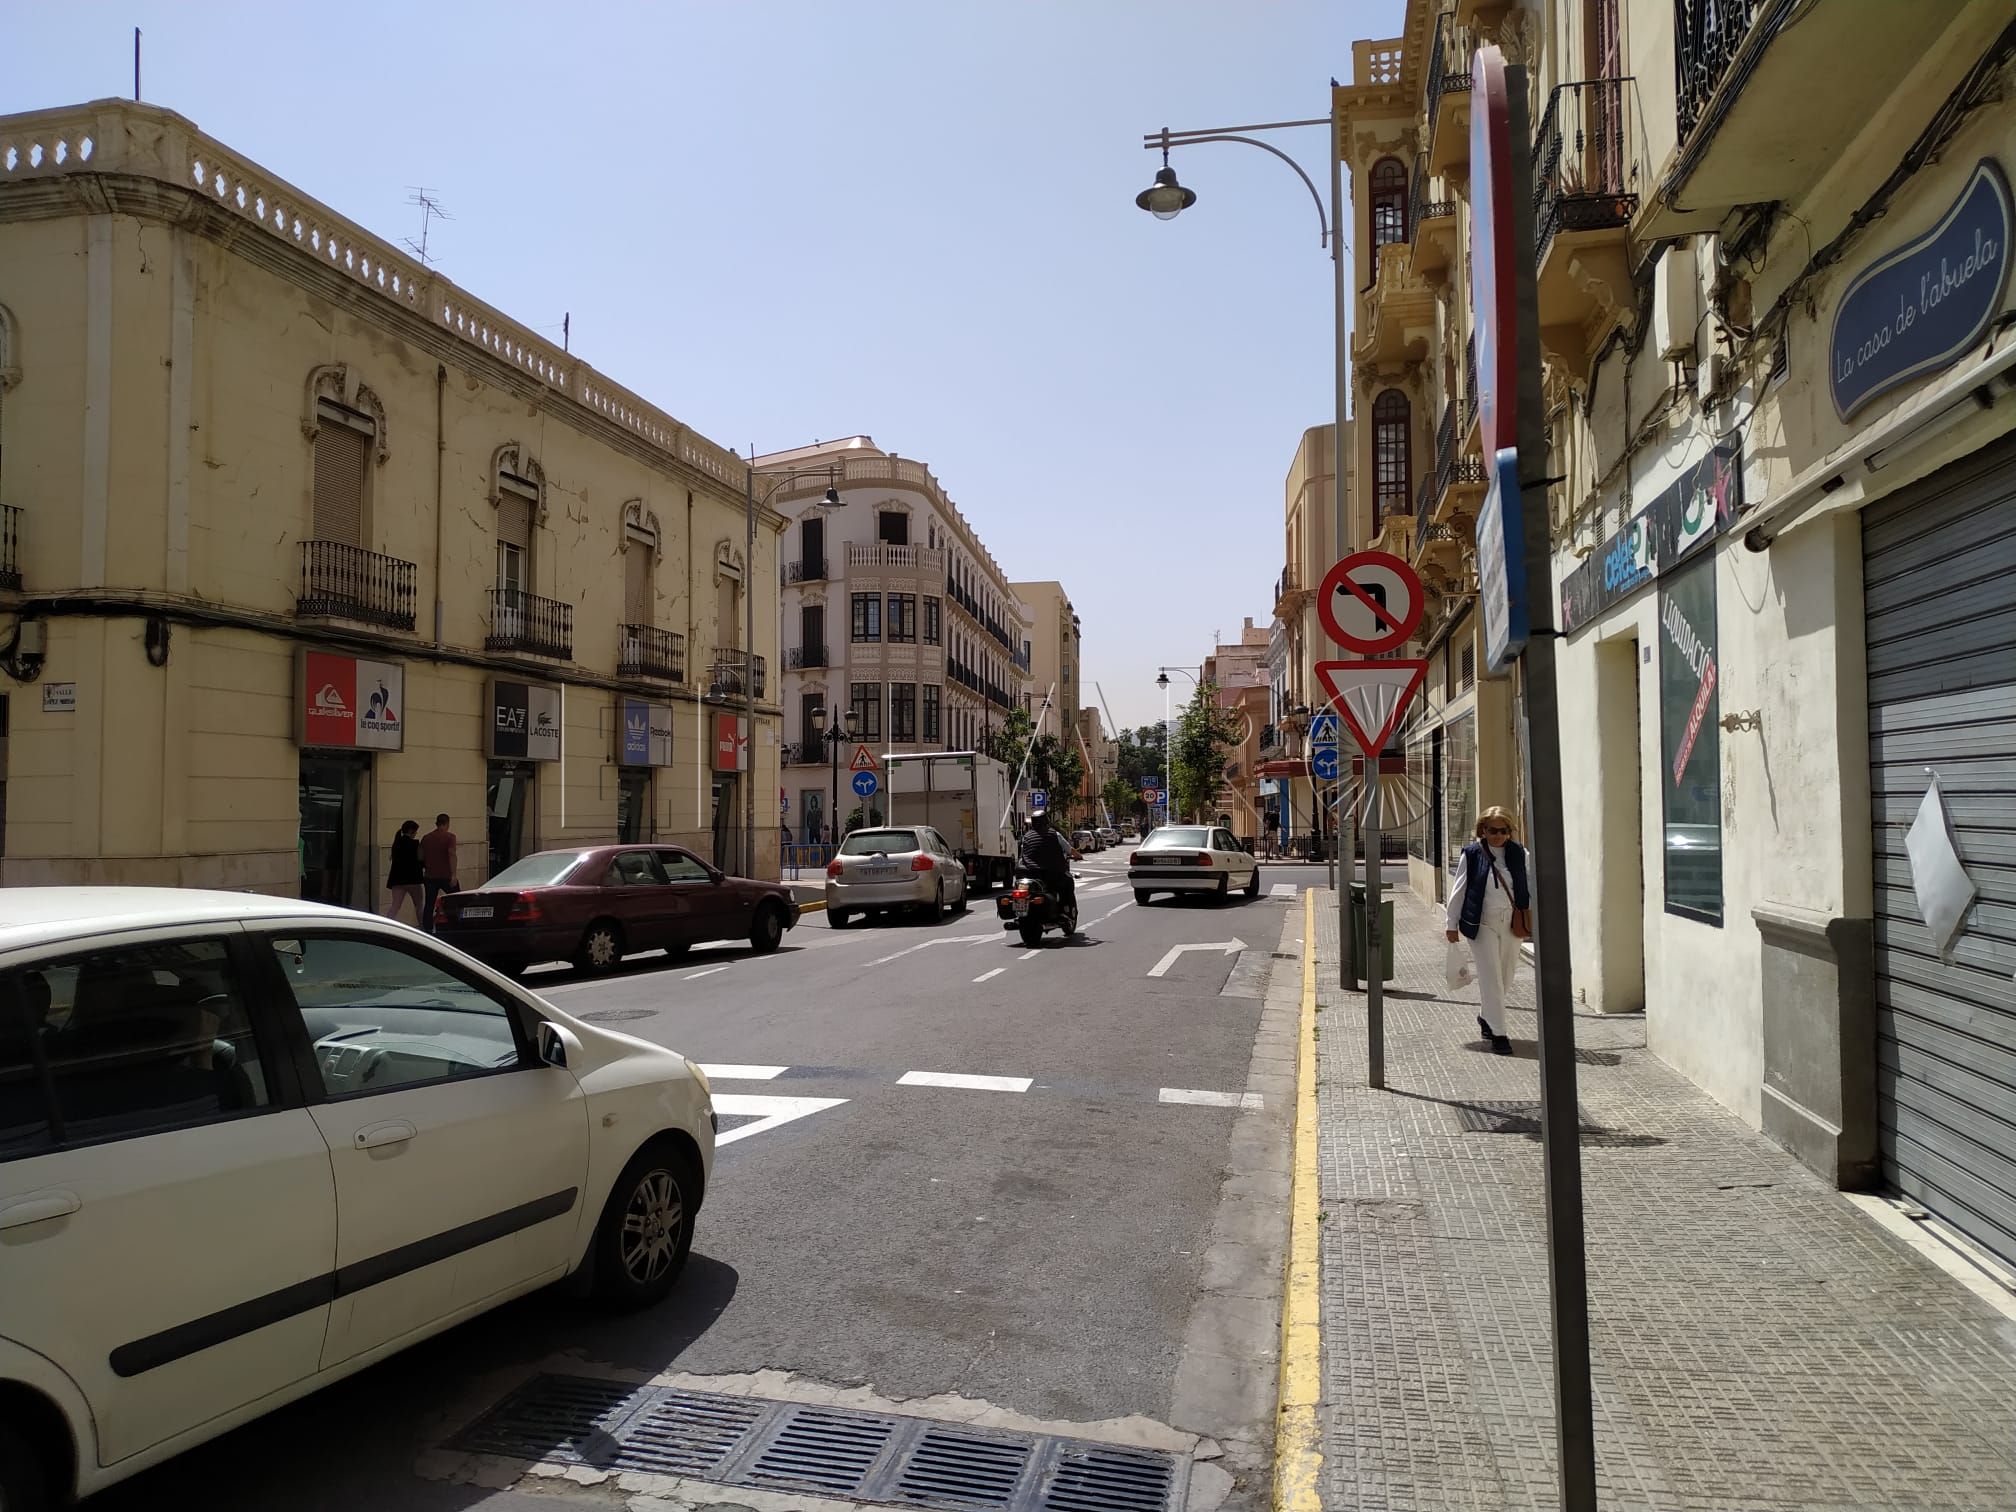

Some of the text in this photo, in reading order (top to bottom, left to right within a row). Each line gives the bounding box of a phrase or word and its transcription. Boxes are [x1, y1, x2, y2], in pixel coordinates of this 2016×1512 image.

[1837, 228, 1998, 383] La casa de l'abuela
[1662, 592, 1713, 684] LIQUIDACIÓ
[1690, 669, 1714, 739] ALQUILA
[496, 705, 527, 729] EA7
[361, 719, 400, 732] le coq sportif
[529, 726, 560, 738] LACOSTE
[627, 741, 647, 752] adidas
[1034, 793, 1044, 806] P
[1156, 791, 1166, 804] P
